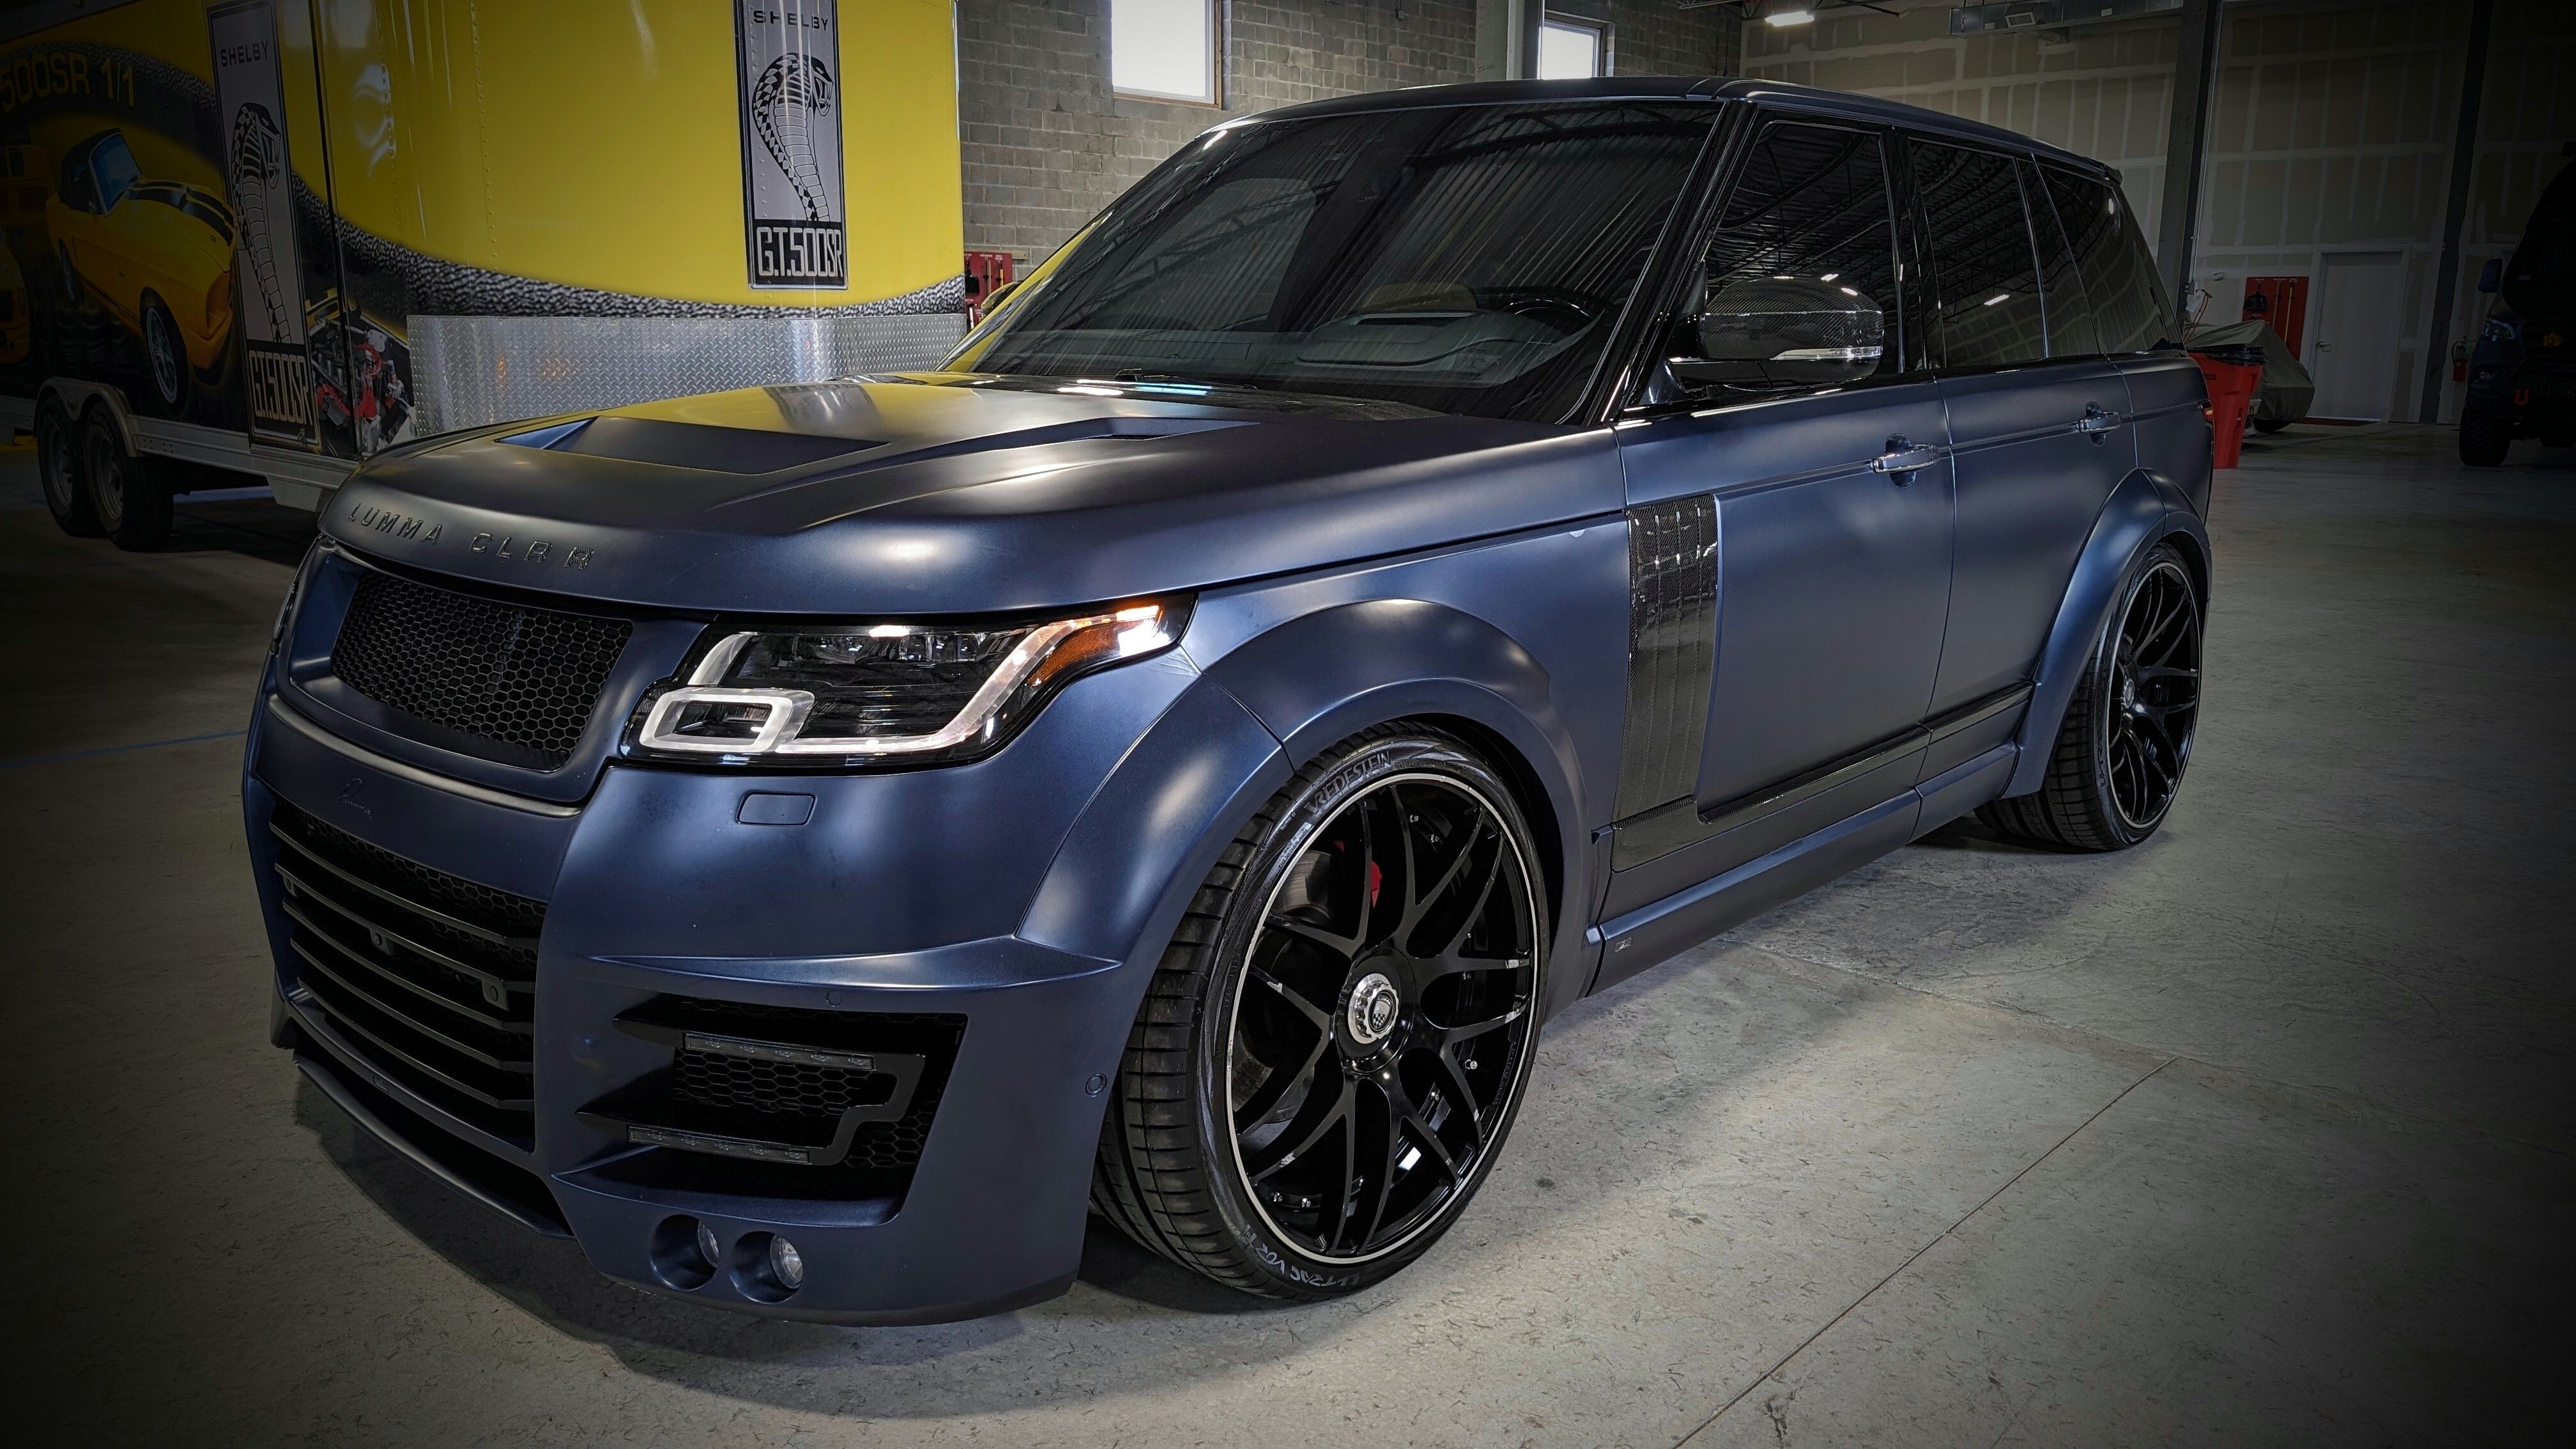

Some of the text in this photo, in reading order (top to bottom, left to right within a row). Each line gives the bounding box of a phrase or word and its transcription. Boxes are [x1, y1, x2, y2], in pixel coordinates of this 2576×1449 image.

[753, 10, 829, 31] SHELBY
[220, 40, 268, 67] SHELBY
[348, 502, 443, 544] LUMMA
[1304, 750, 1391, 815] VREDESTEIN
